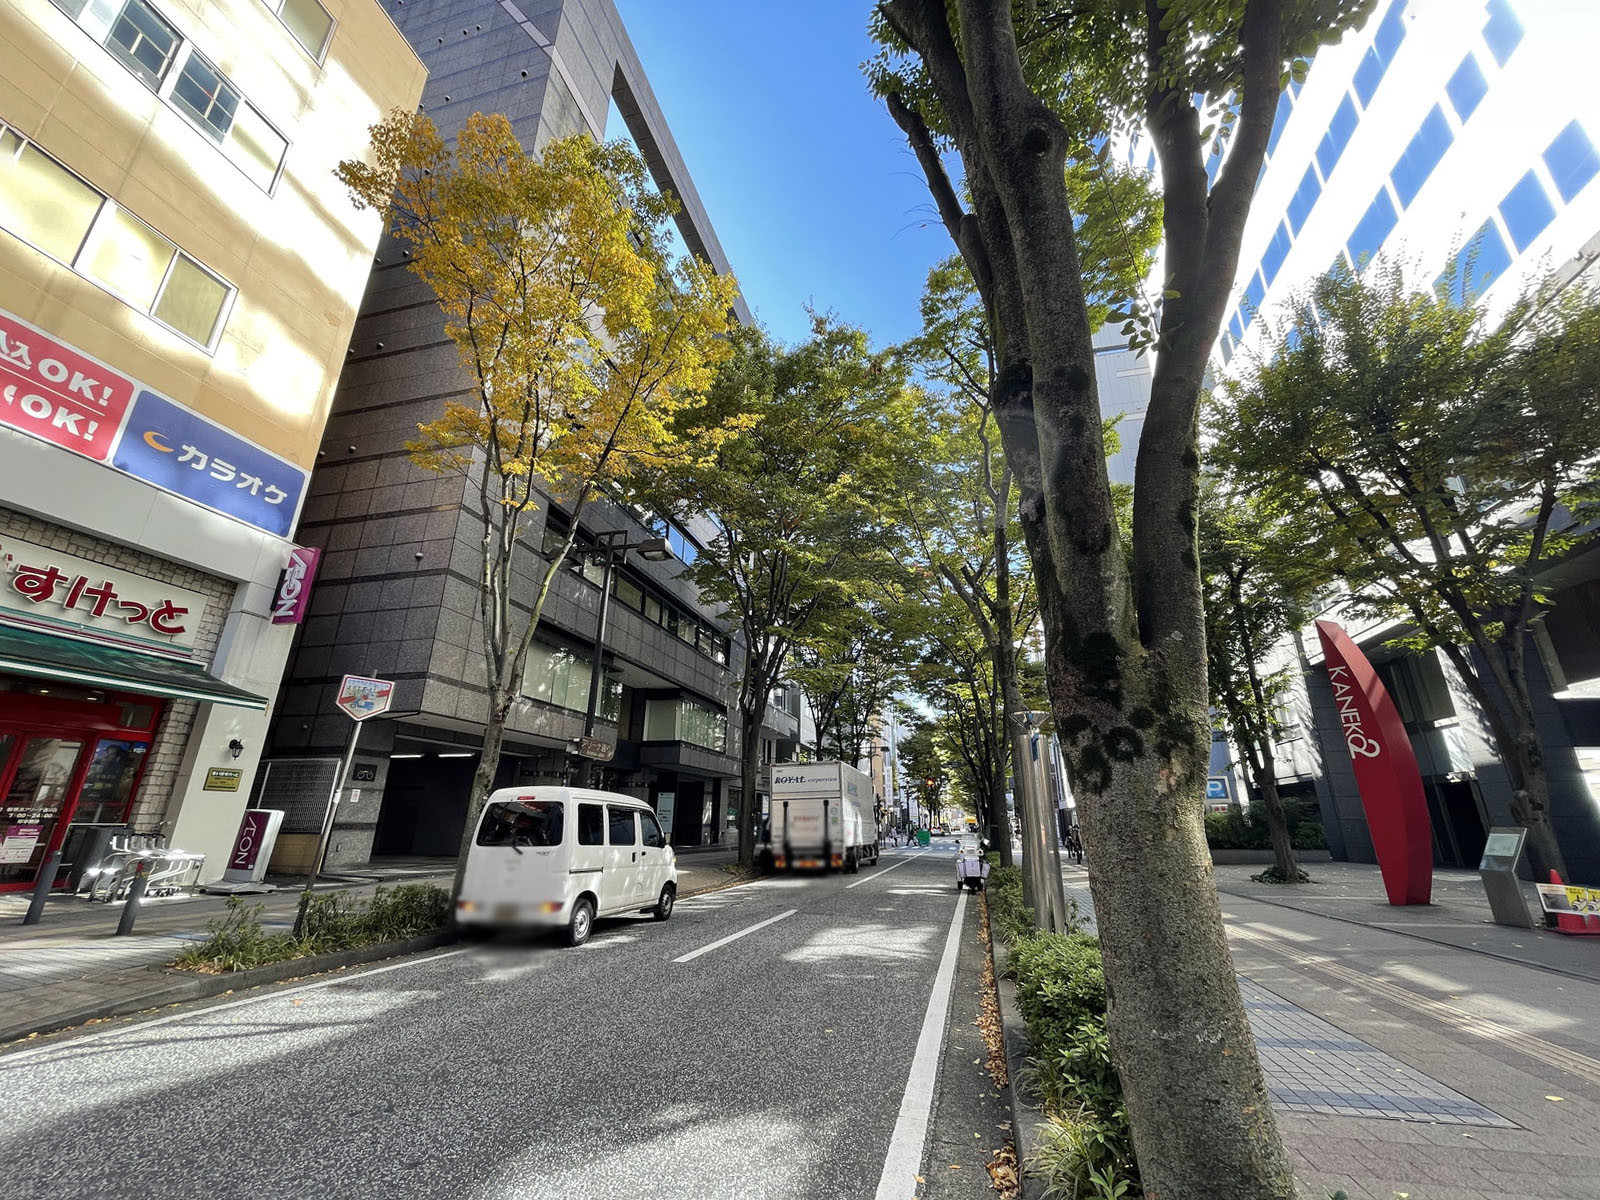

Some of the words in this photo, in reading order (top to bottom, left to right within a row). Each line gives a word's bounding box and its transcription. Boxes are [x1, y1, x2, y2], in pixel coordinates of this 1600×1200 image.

[177, 444, 288, 505] カラオケ
[7, 553, 189, 634] すけっと
[775, 776, 806, 784] ROYAL
